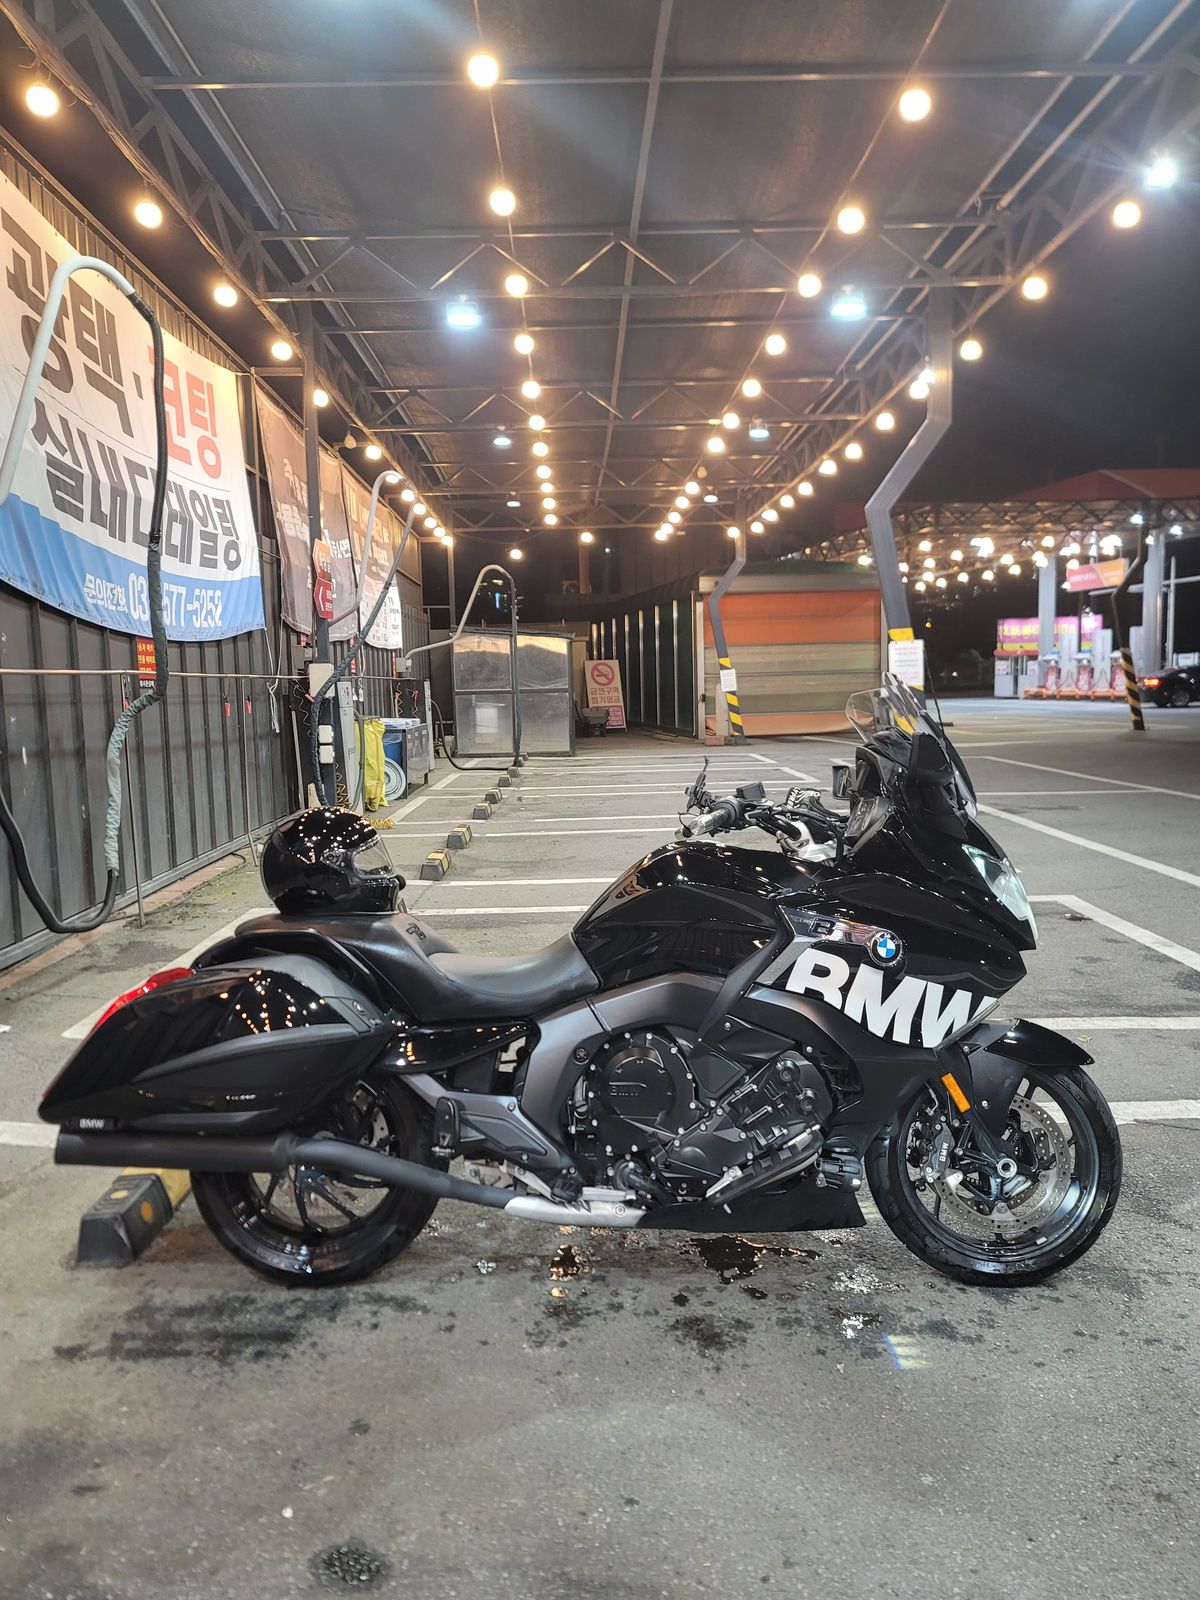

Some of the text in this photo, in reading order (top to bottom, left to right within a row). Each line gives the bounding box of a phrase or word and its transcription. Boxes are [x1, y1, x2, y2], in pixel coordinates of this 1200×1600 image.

[128, 572, 223, 628] 03577-5252
[786, 948, 998, 1048] BMW
[79, 1118, 105, 1129] BMW
[939, 1141, 949, 1161] BMW
